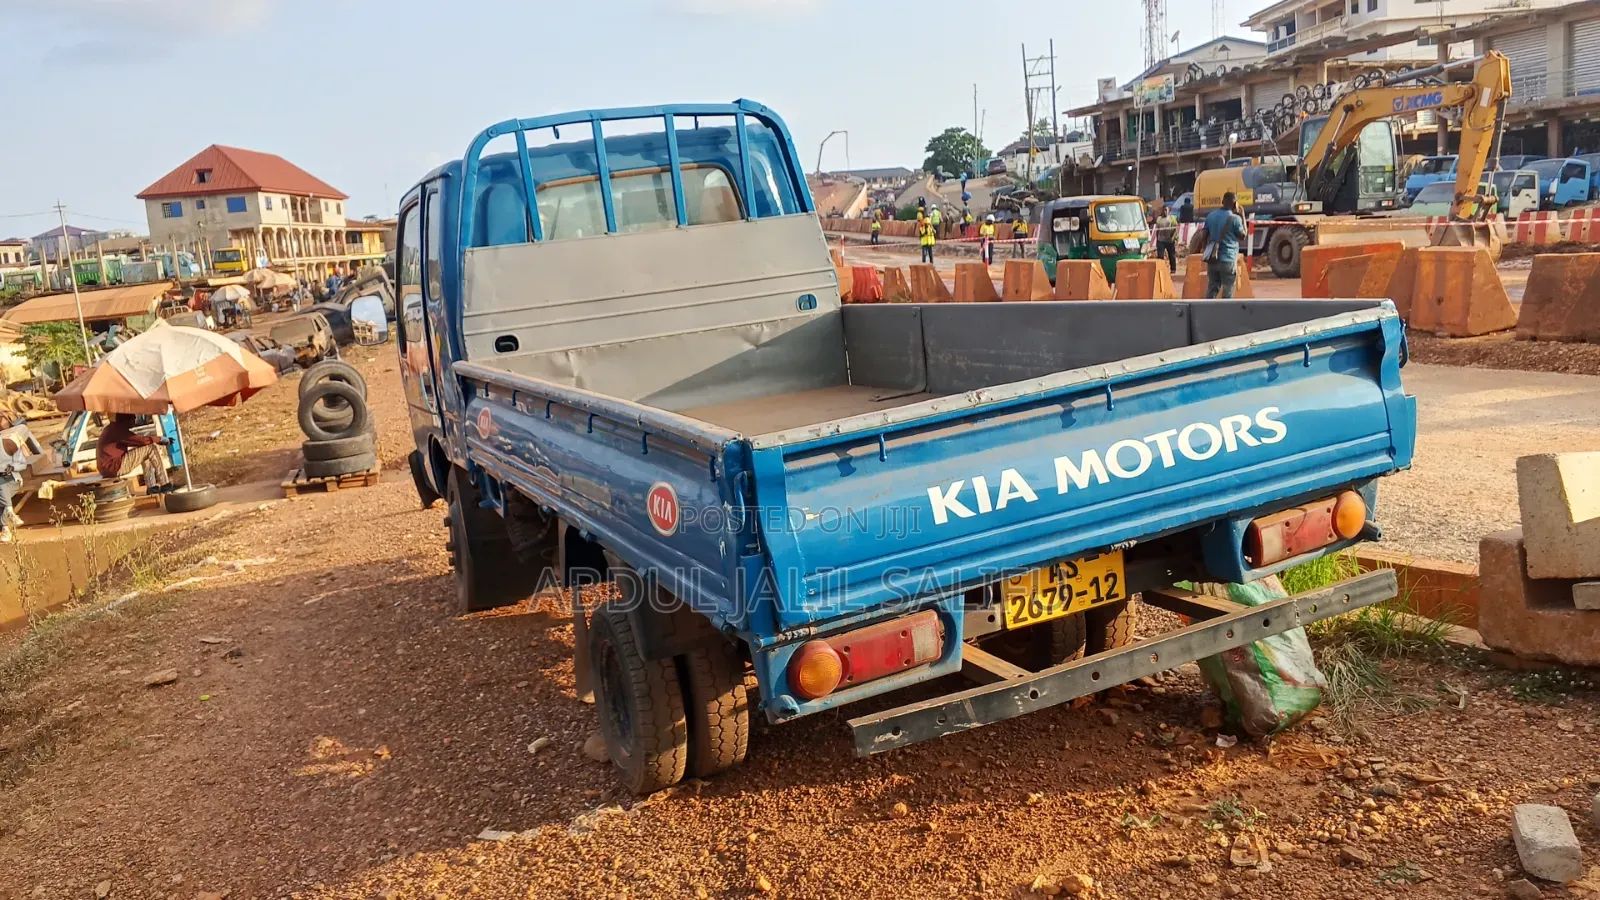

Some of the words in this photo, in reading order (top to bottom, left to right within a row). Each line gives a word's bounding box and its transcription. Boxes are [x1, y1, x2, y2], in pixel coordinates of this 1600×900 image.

[1403, 91, 1443, 110] XCMG
[926, 467, 1039, 525] KIA
[1053, 406, 1289, 496] MOTORS
[653, 494, 673, 523] KIA
[1012, 572, 1120, 625] 2679-12
